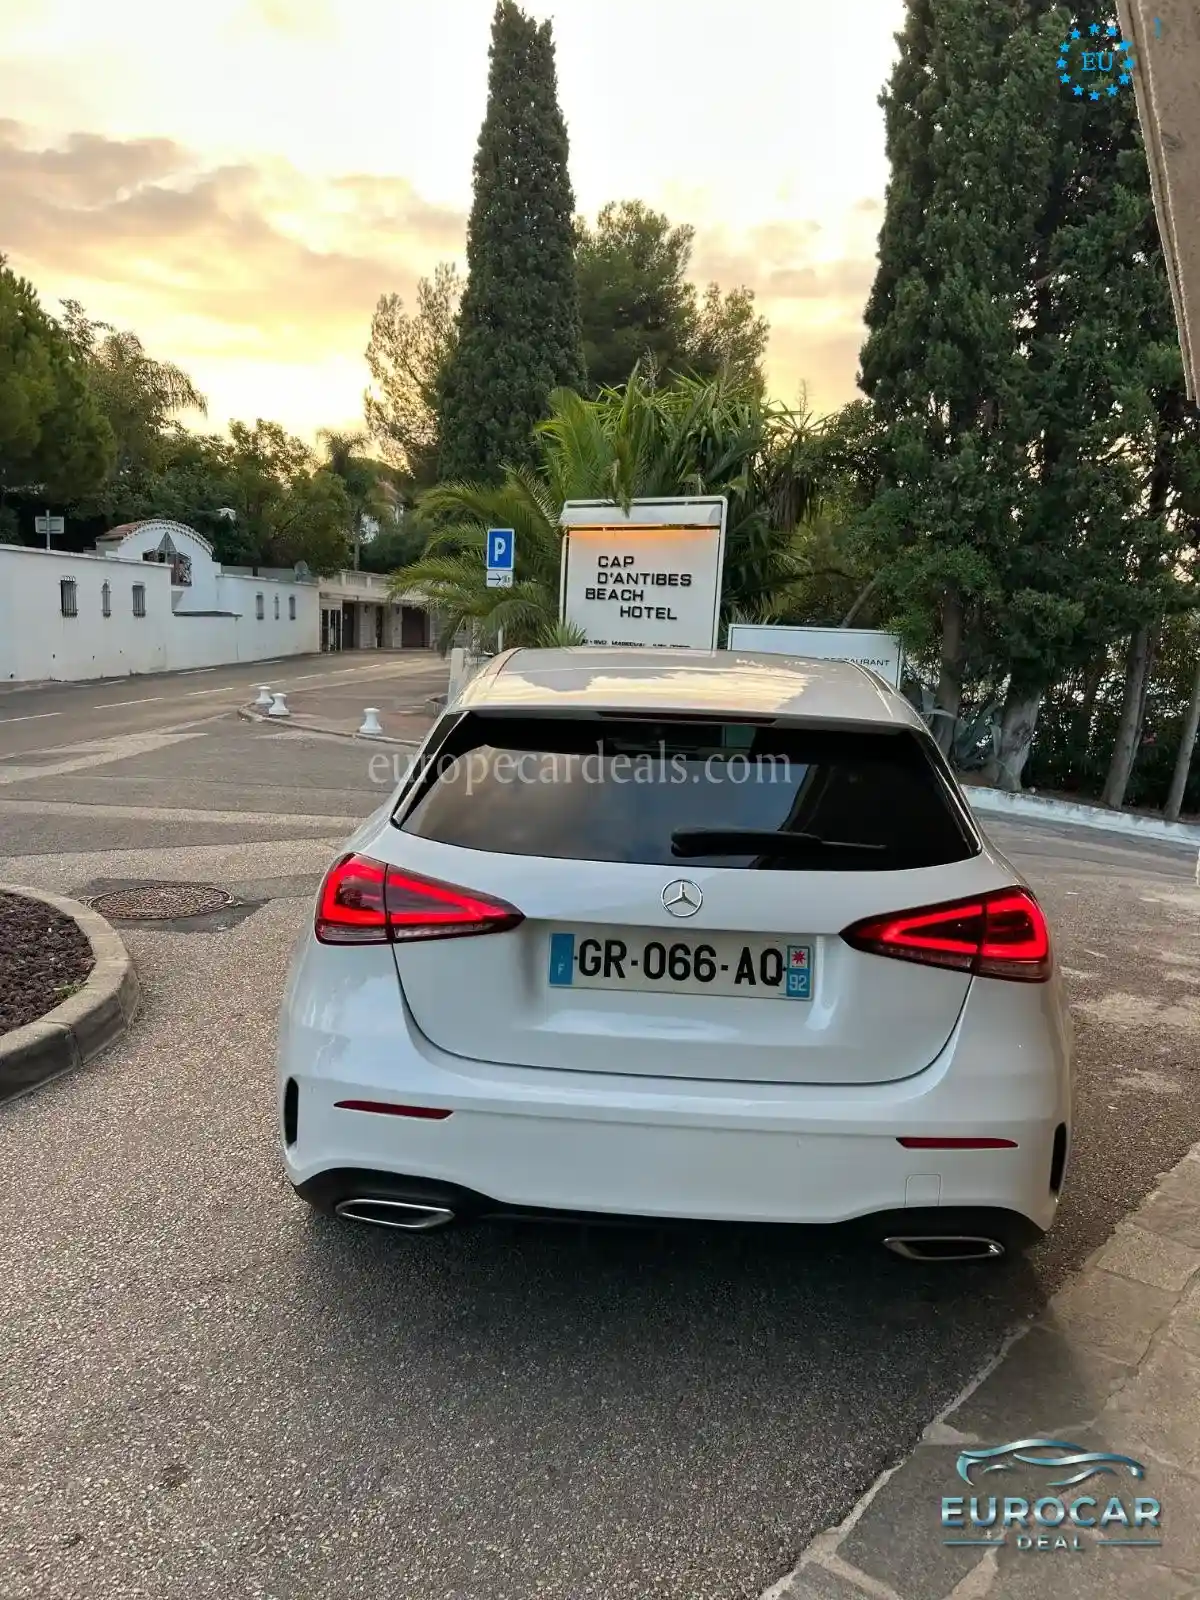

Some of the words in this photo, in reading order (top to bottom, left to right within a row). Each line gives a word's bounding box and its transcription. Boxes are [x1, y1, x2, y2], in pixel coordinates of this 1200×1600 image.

[494, 537, 506, 562] P
[597, 555, 635, 569] CAP
[597, 572, 693, 587] D'ANTIBES
[585, 587, 645, 601] BEACH
[620, 605, 678, 620] HOTEL
[823, 656, 891, 667] AURANT
[578, 938, 784, 987] GR-066-AQ
[788, 974, 808, 992] 92
